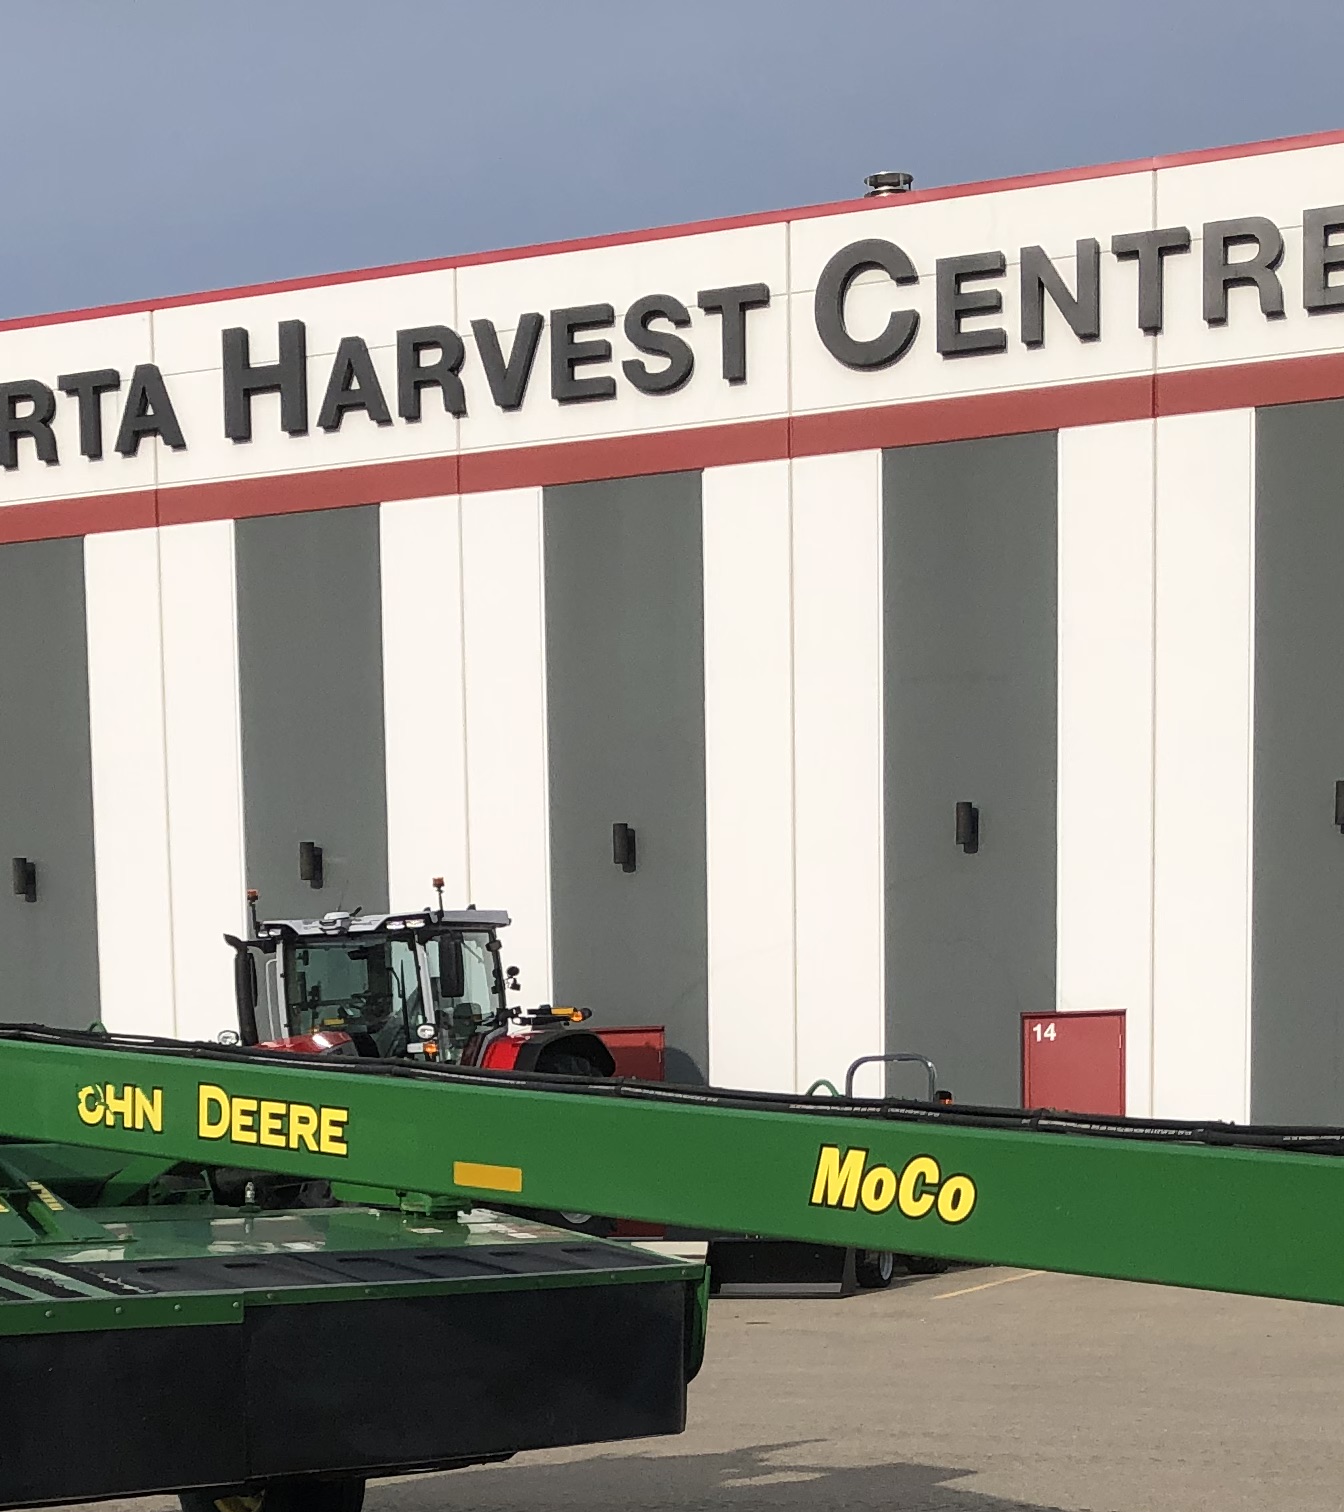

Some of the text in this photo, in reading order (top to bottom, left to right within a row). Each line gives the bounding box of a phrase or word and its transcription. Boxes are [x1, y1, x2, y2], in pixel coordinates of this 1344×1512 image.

[220, 282, 770, 445] HARVEST
[1032, 1022, 1056, 1042] 14
[197, 1083, 349, 1157] DEERE
[809, 1144, 977, 1225] MoCo
